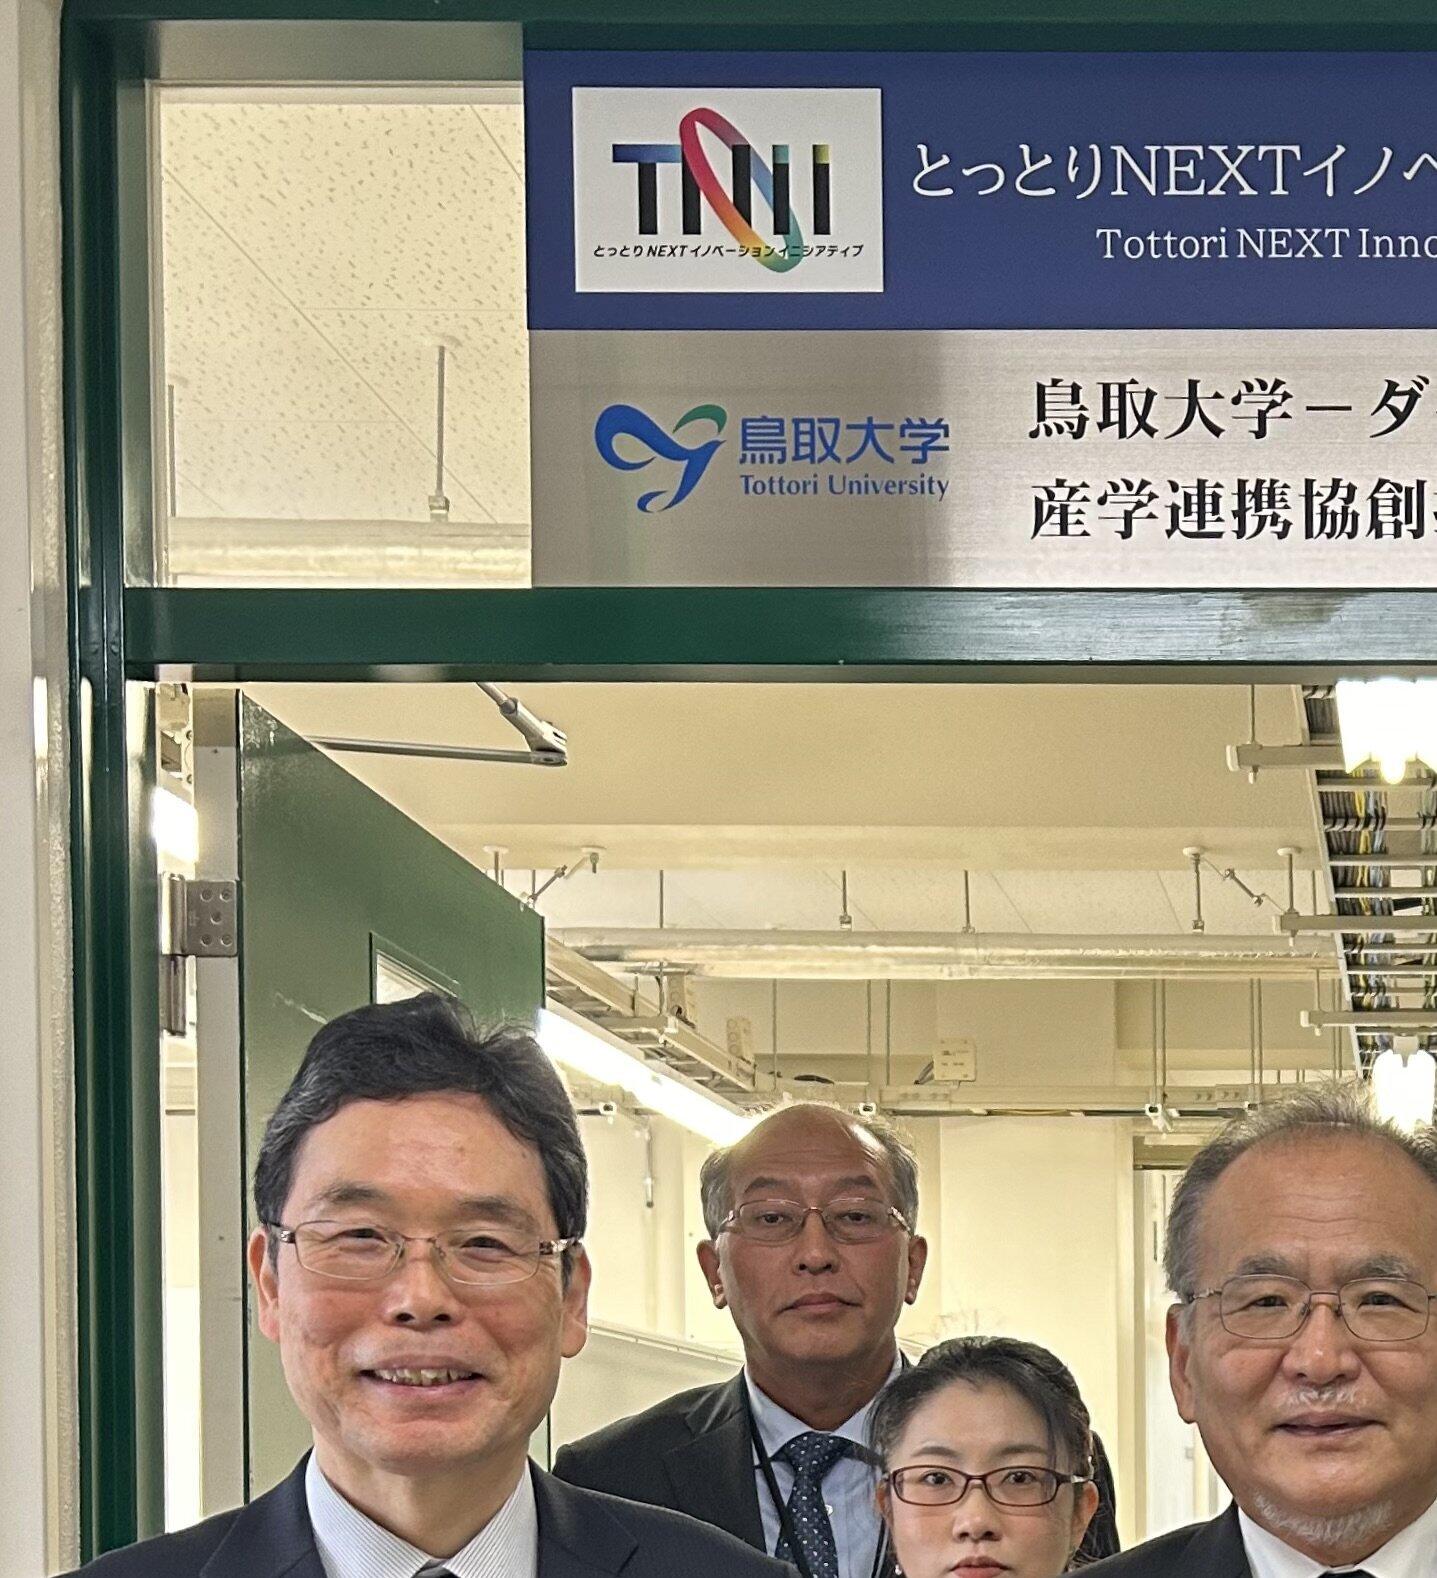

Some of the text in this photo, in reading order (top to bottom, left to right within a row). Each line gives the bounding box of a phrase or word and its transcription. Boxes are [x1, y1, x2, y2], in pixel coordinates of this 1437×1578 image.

[1095, 225, 1229, 260] Tottori
[1236, 226, 1350, 260] NEXT
[739, 415, 950, 465] 鳥取大学
[739, 472, 950, 502] Tottori University
